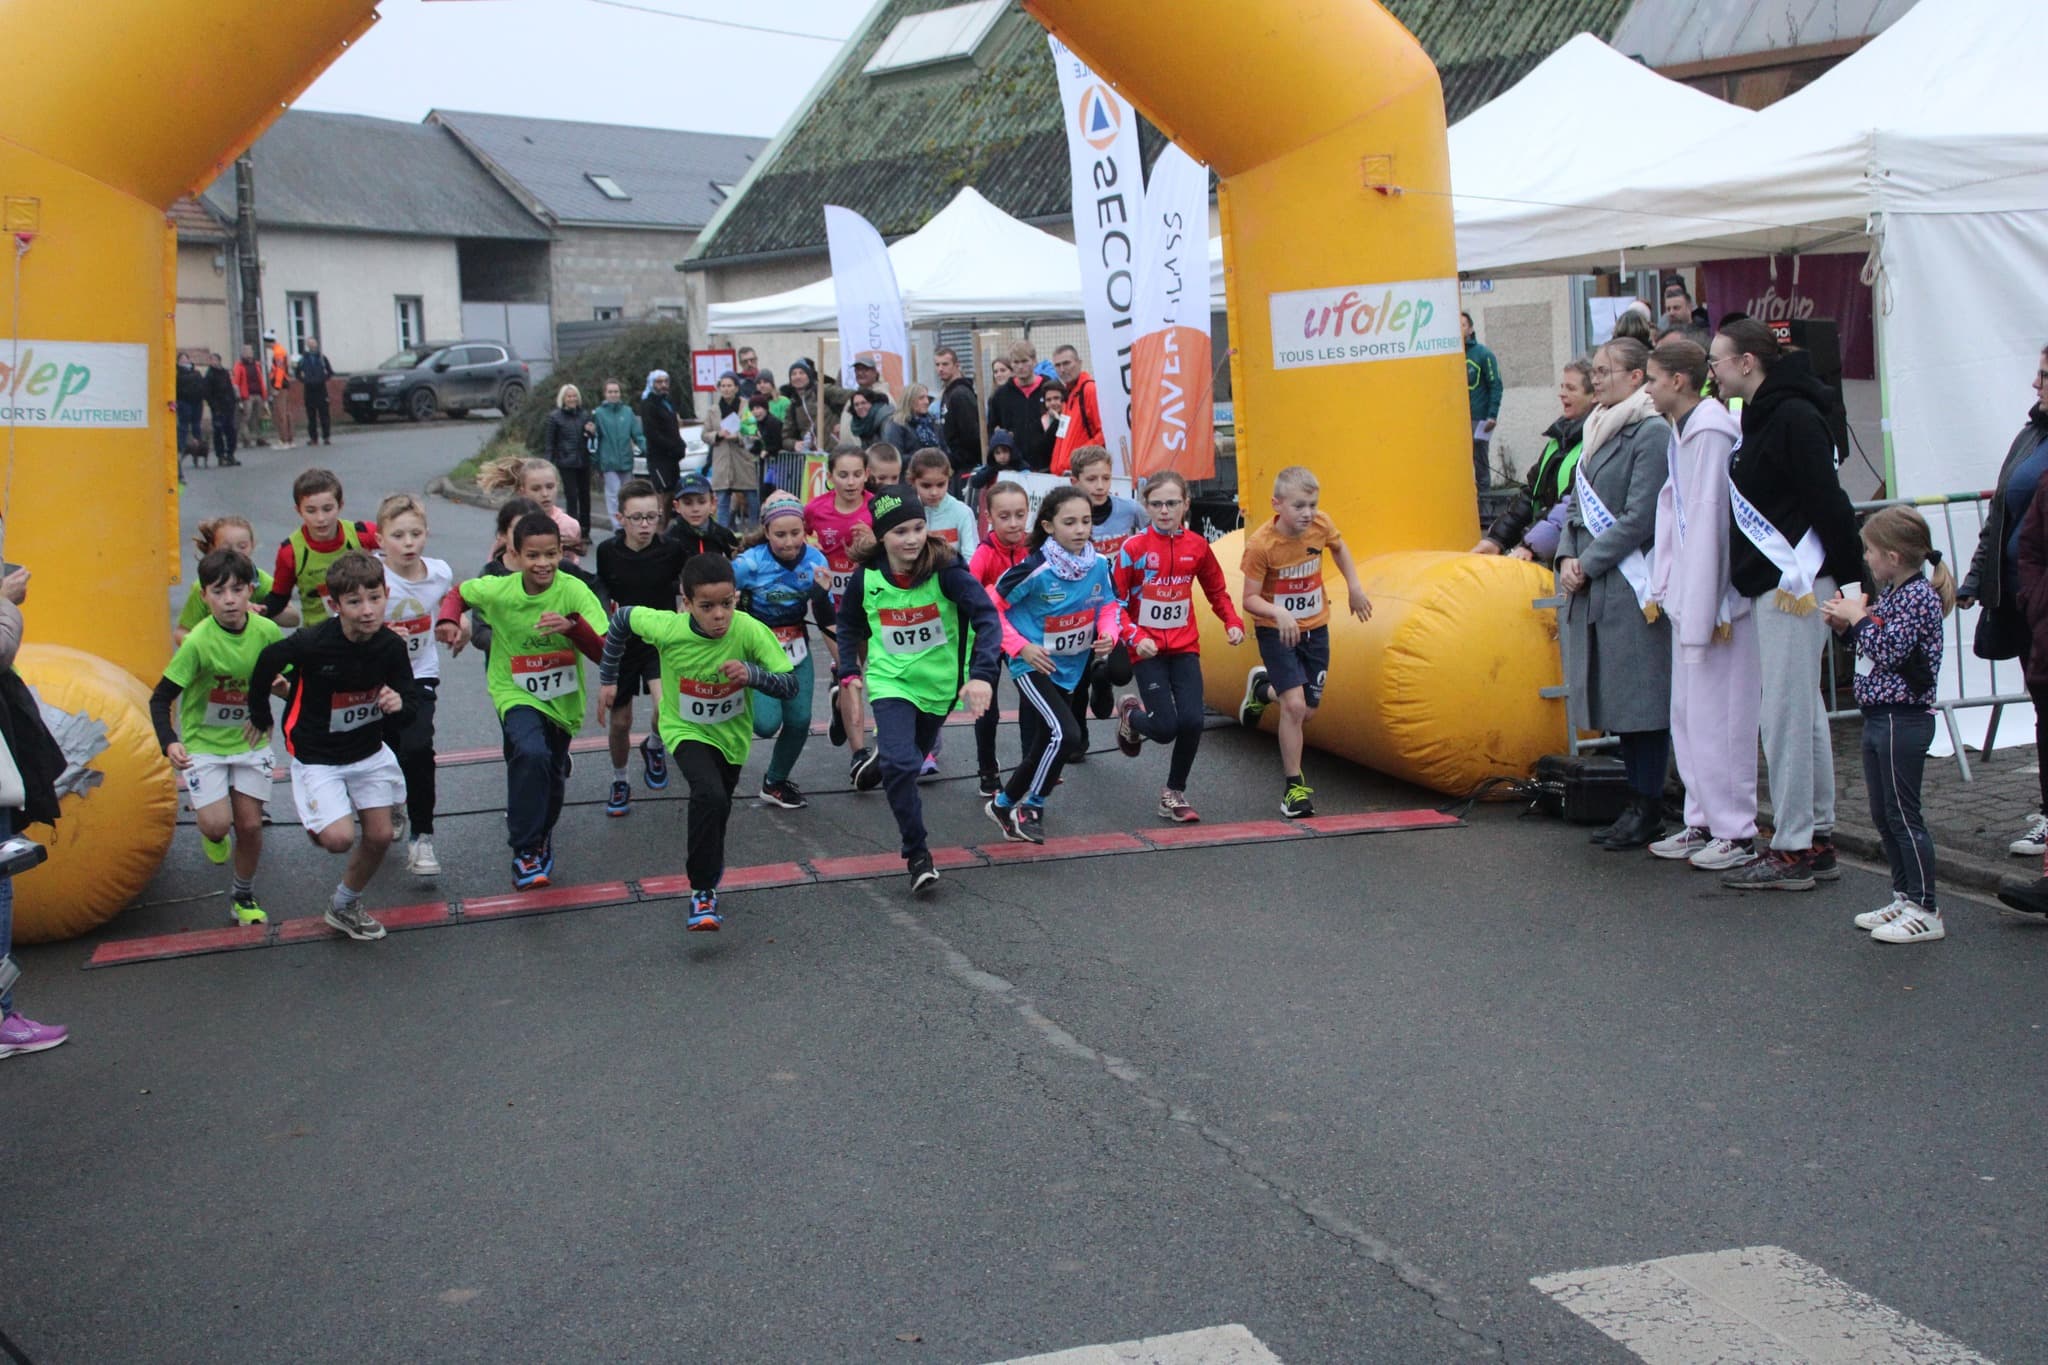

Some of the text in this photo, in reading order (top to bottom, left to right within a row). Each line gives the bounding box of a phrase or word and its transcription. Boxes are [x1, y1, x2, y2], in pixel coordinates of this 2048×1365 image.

[1304, 289, 1434, 349] ufolep
[1279, 350, 1314, 363] TOUS
[1319, 346, 1345, 360] LES
[1350, 342, 1406, 358] SPORTS
[0, 408, 143, 422] ORTS AUTREMENT
[1285, 594, 1315, 611] 084
[1151, 605, 1181, 620] 083
[893, 627, 931, 645] 078
[1056, 631, 1085, 651] 079
[526, 672, 563, 692] 077
[218, 708, 250, 720] 09
[692, 700, 732, 717] 076
